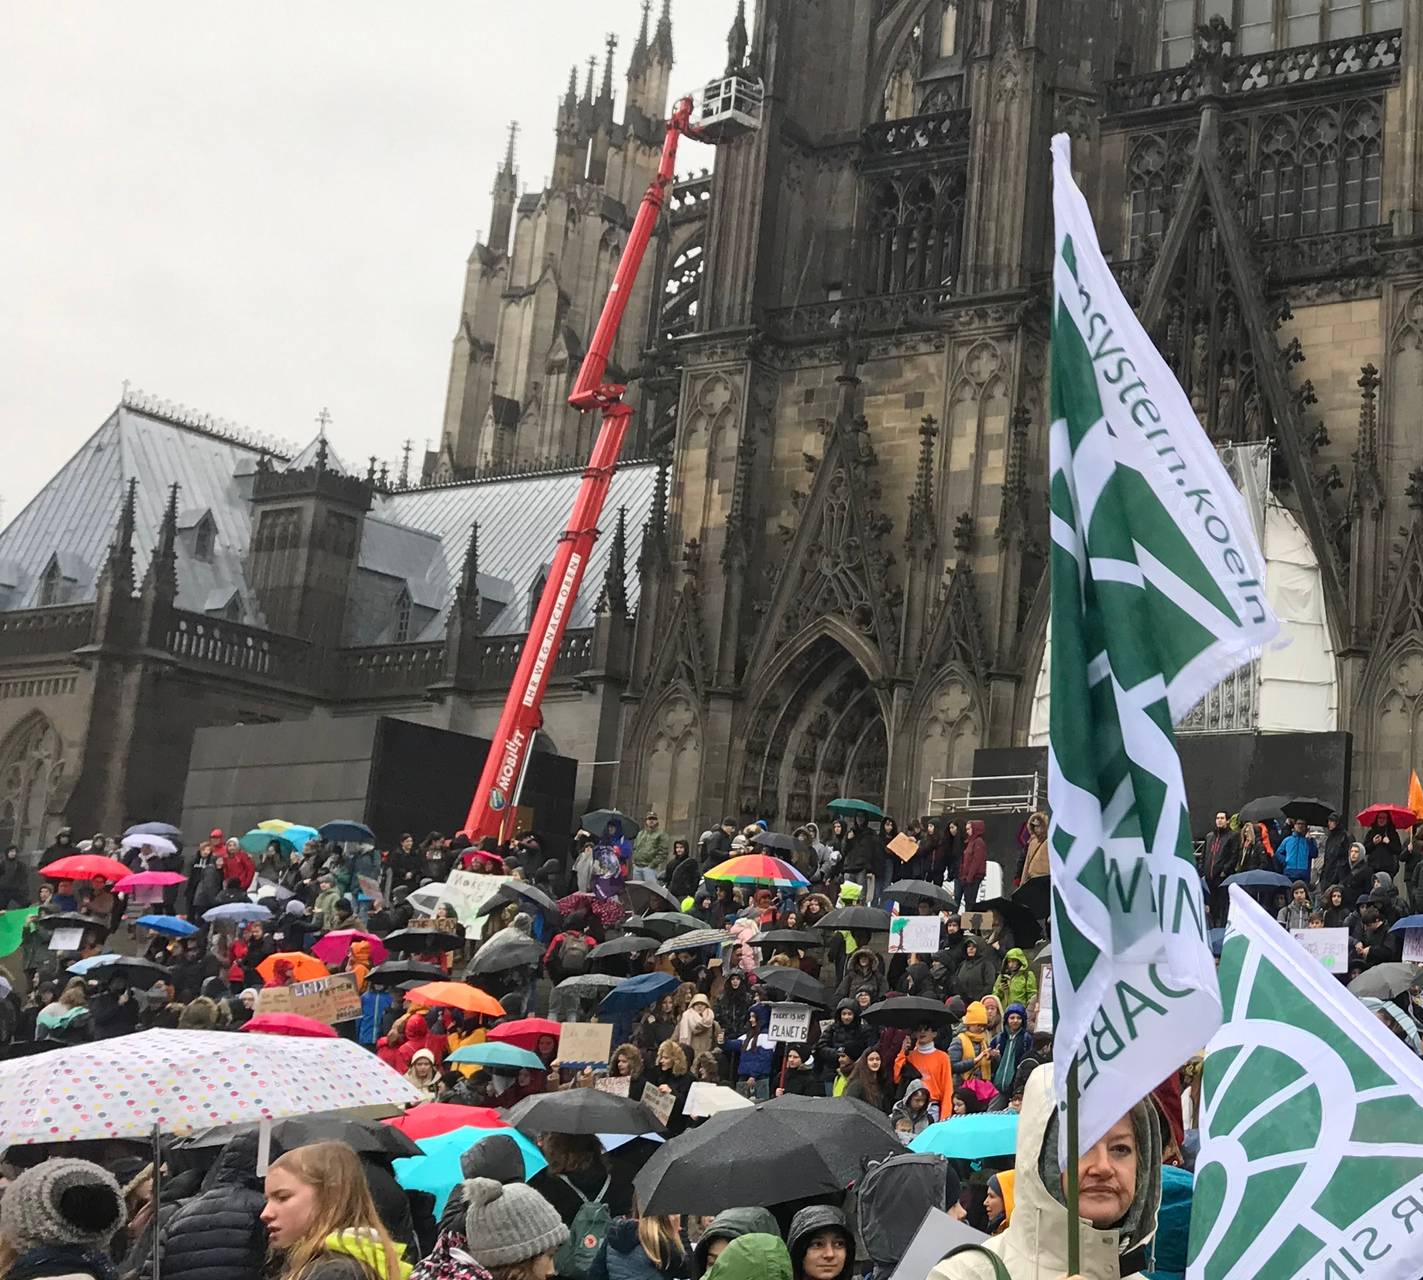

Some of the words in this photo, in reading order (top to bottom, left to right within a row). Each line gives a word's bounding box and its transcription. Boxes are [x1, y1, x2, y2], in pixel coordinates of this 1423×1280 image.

[525, 681, 538, 704] IHR
[534, 646, 550, 675] WEG
[546, 602, 565, 641] NACH
[770, 1024, 800, 1038] PLANET
[800, 1026, 808, 1040] B
